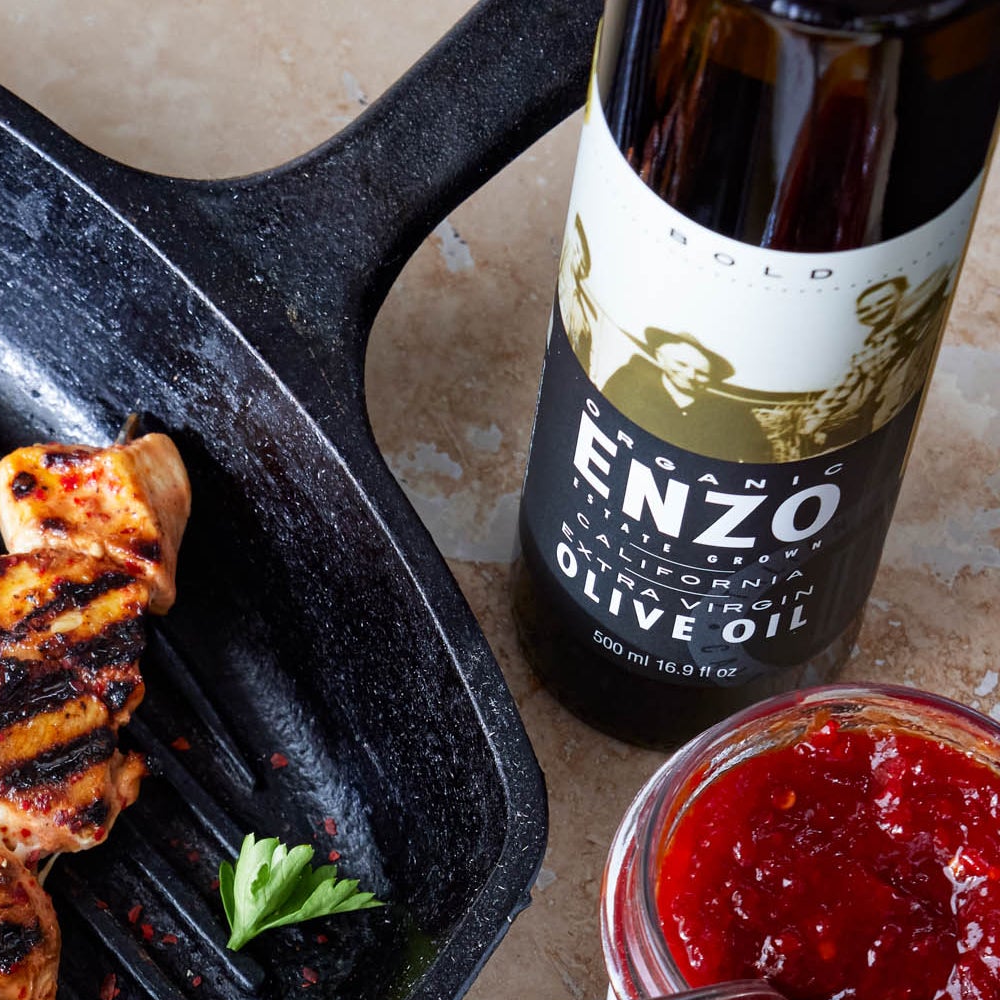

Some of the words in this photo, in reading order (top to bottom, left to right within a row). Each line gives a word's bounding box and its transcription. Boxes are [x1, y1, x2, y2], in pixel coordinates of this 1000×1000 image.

[670, 228, 833, 279] BOLD
[573, 410, 841, 549] ENZO
[586, 398, 844, 489] ORGANIC
[573, 476, 672, 553] ESTATE
[707, 540, 822, 565] GROWN
[576, 512, 804, 589] CALIFORNIA
[556, 541, 696, 642] OLIVE
[721, 604, 808, 644] OIL
[561, 521, 660, 602] EXTRA
[680, 585, 814, 613] VIRGIN
[592, 629, 624, 656] 500
[627, 651, 649, 667] ml
[656, 659, 694, 676] 16.9
[699, 666, 712, 678] fl
[716, 667, 738, 678] oz
